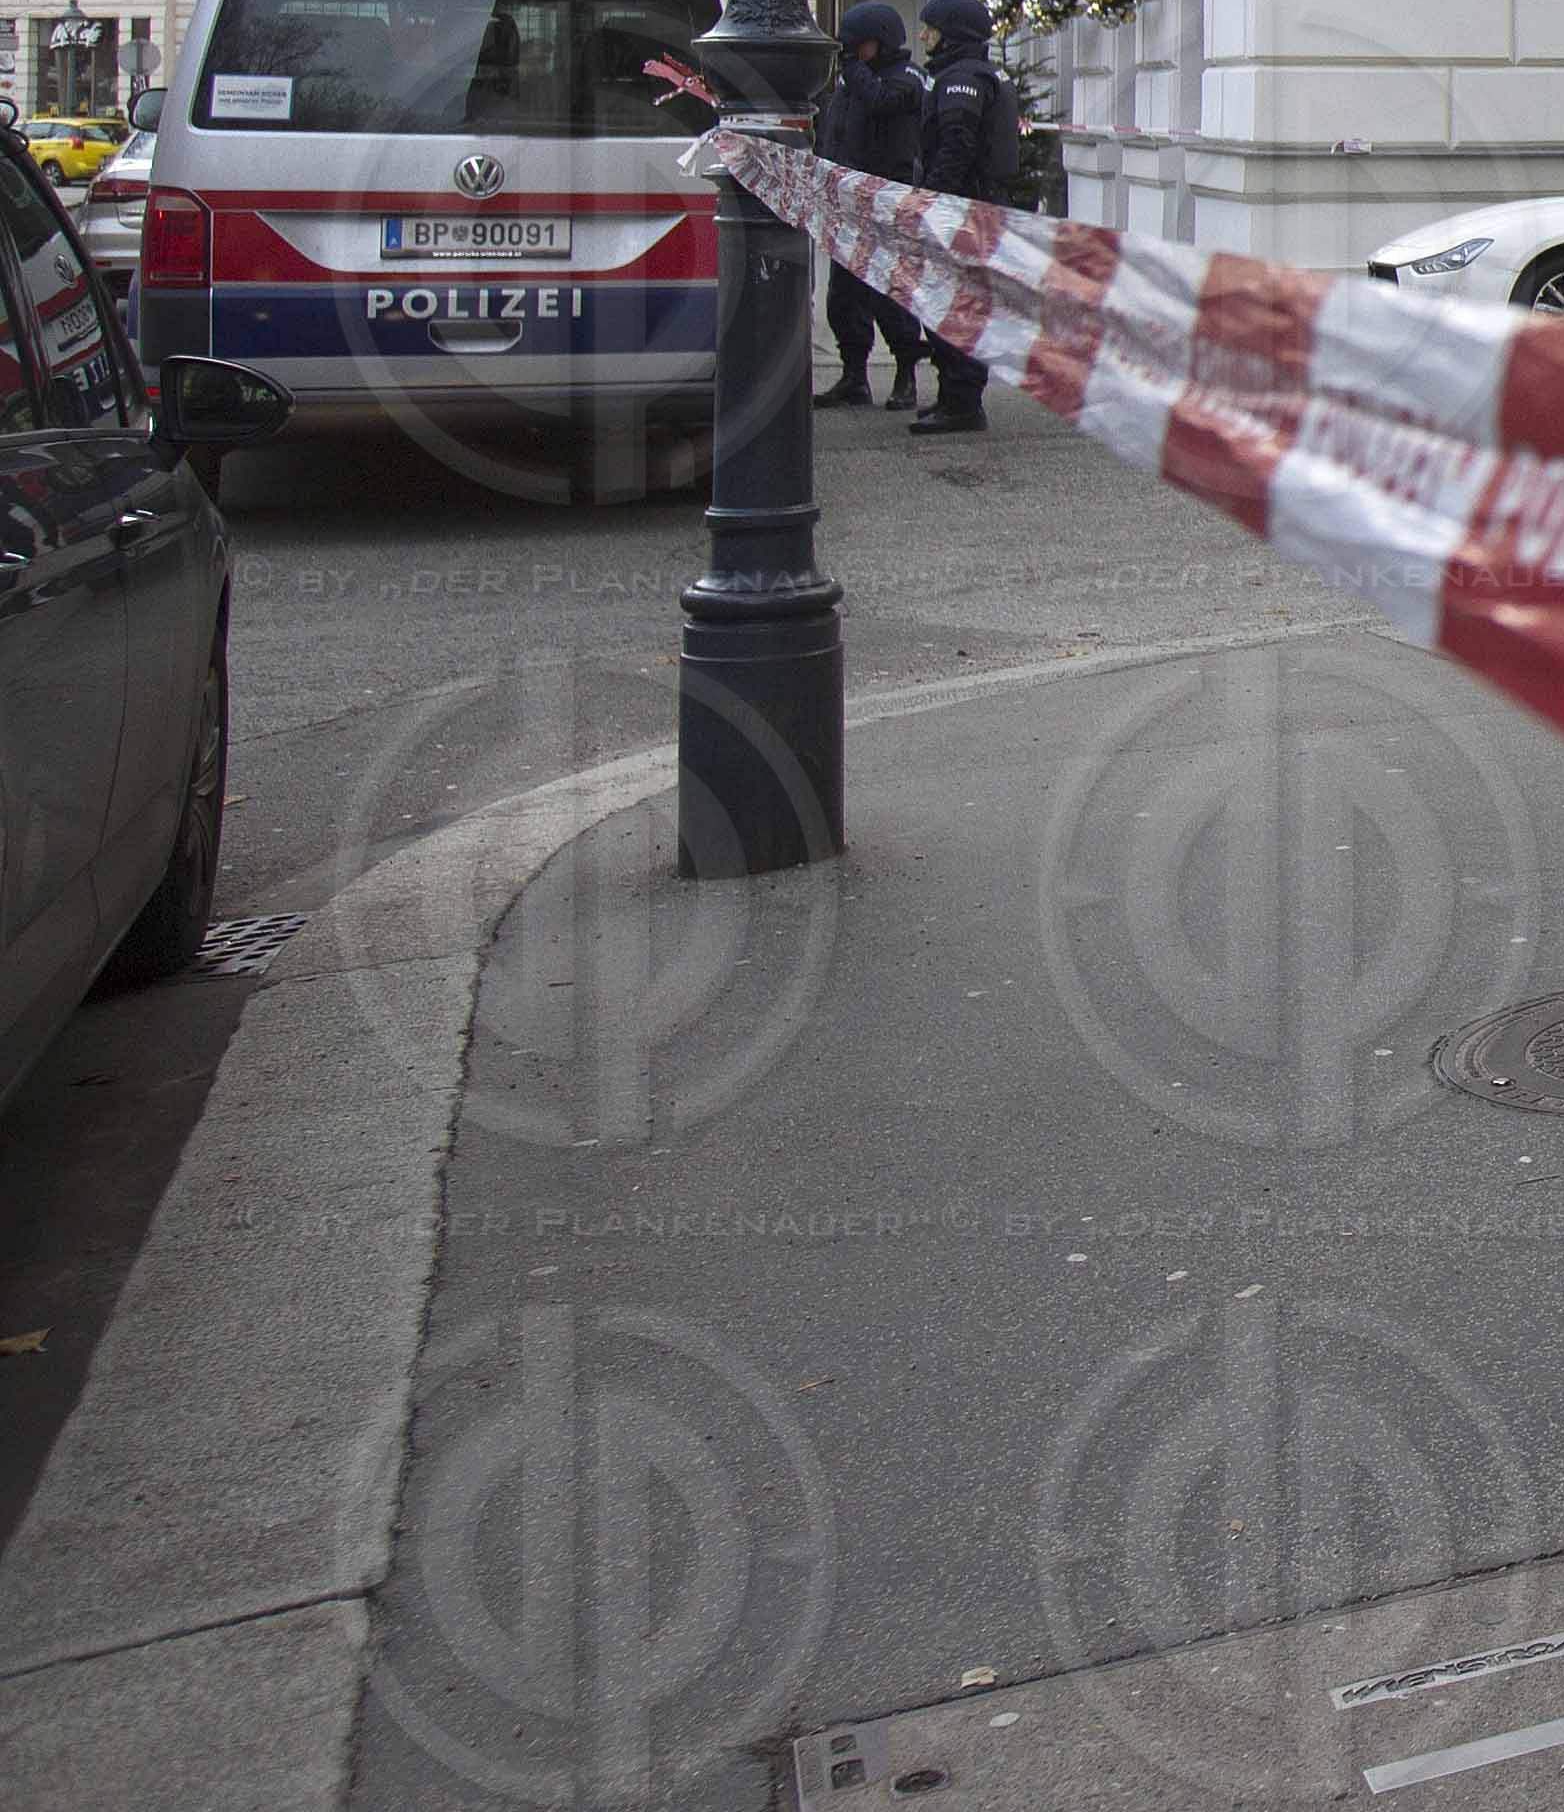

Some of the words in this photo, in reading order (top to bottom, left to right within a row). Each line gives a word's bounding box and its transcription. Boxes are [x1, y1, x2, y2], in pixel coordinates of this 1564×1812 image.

[415, 222, 449, 246] BP
[472, 222, 555, 246] 90091
[367, 288, 583, 319] POLIZEI
